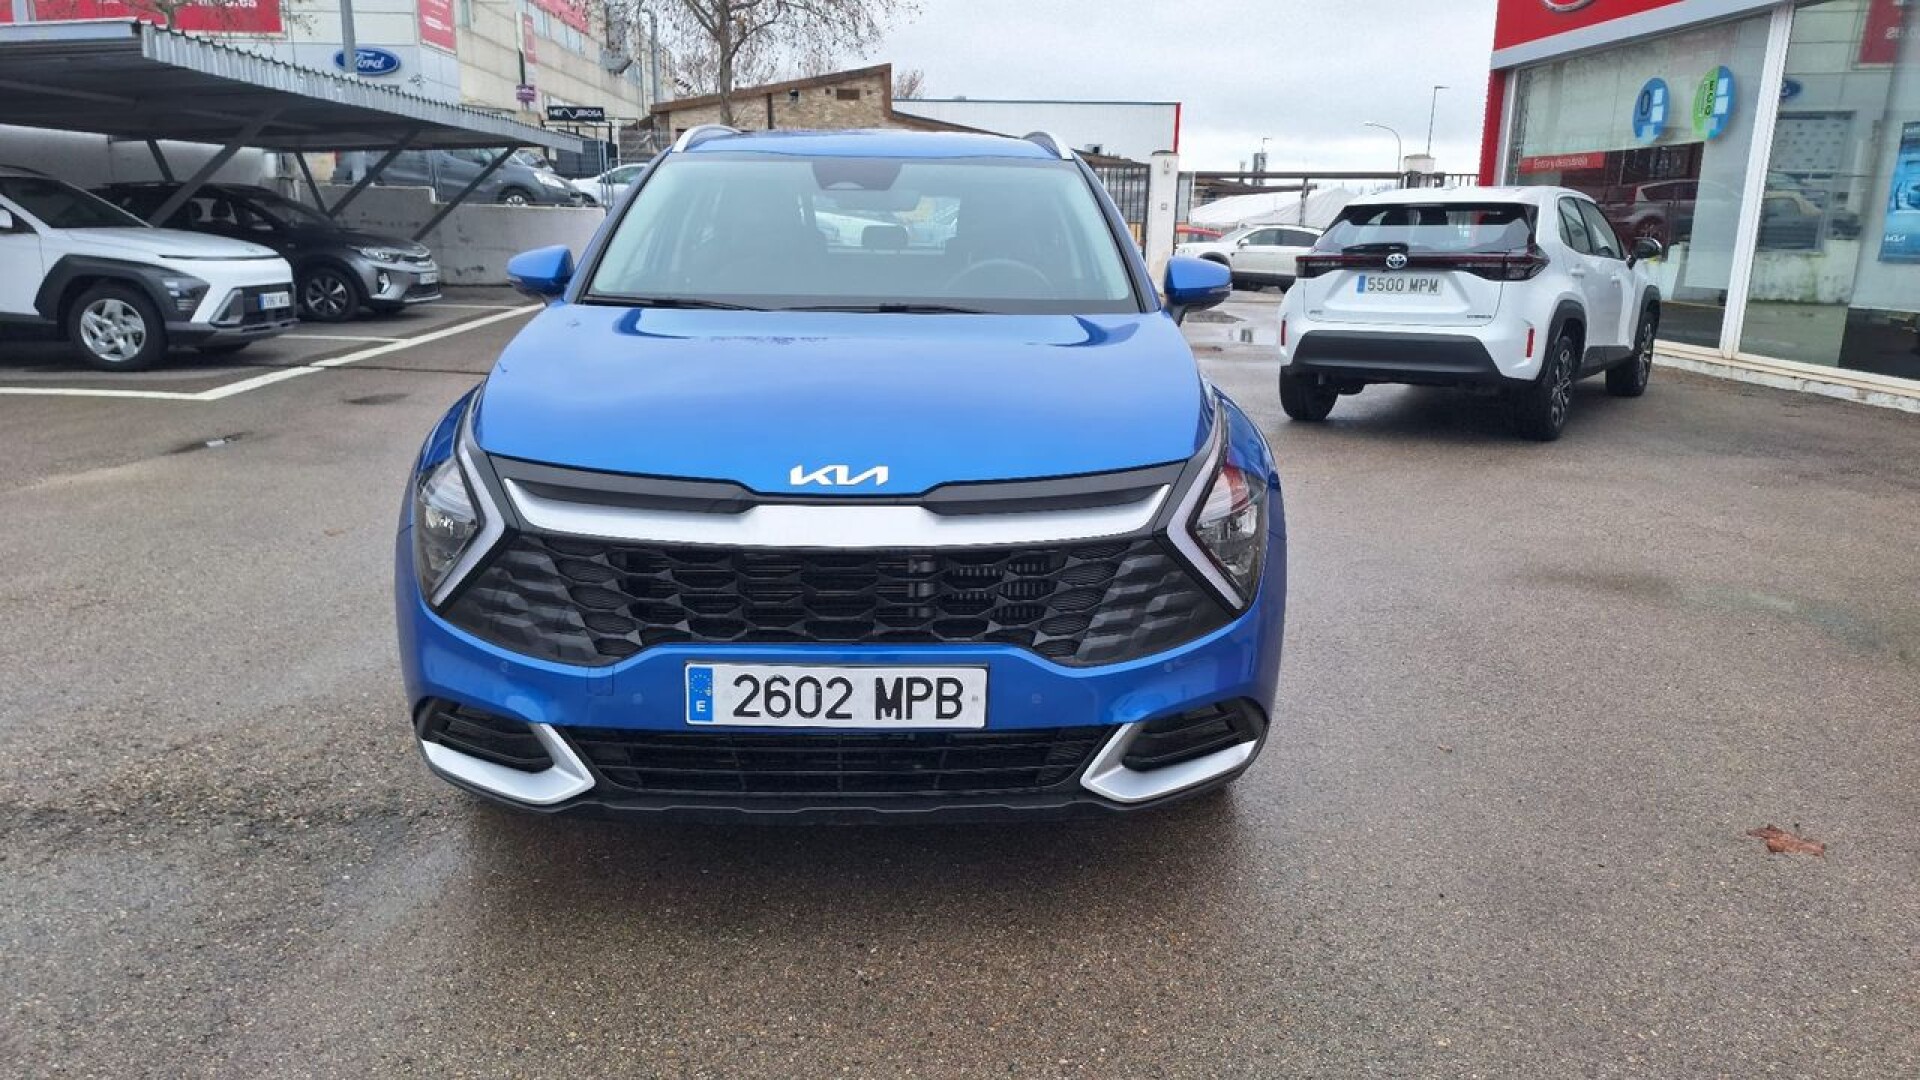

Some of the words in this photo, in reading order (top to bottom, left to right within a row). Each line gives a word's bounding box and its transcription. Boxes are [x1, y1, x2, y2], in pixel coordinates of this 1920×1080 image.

[354, 51, 385, 70] Ford
[1367, 277, 1404, 292] 5500
[1409, 278, 1439, 293] MPM
[789, 464, 889, 486] KIA
[695, 700, 706, 712] E
[732, 674, 853, 720] 2602
[875, 676, 964, 721] MPB
